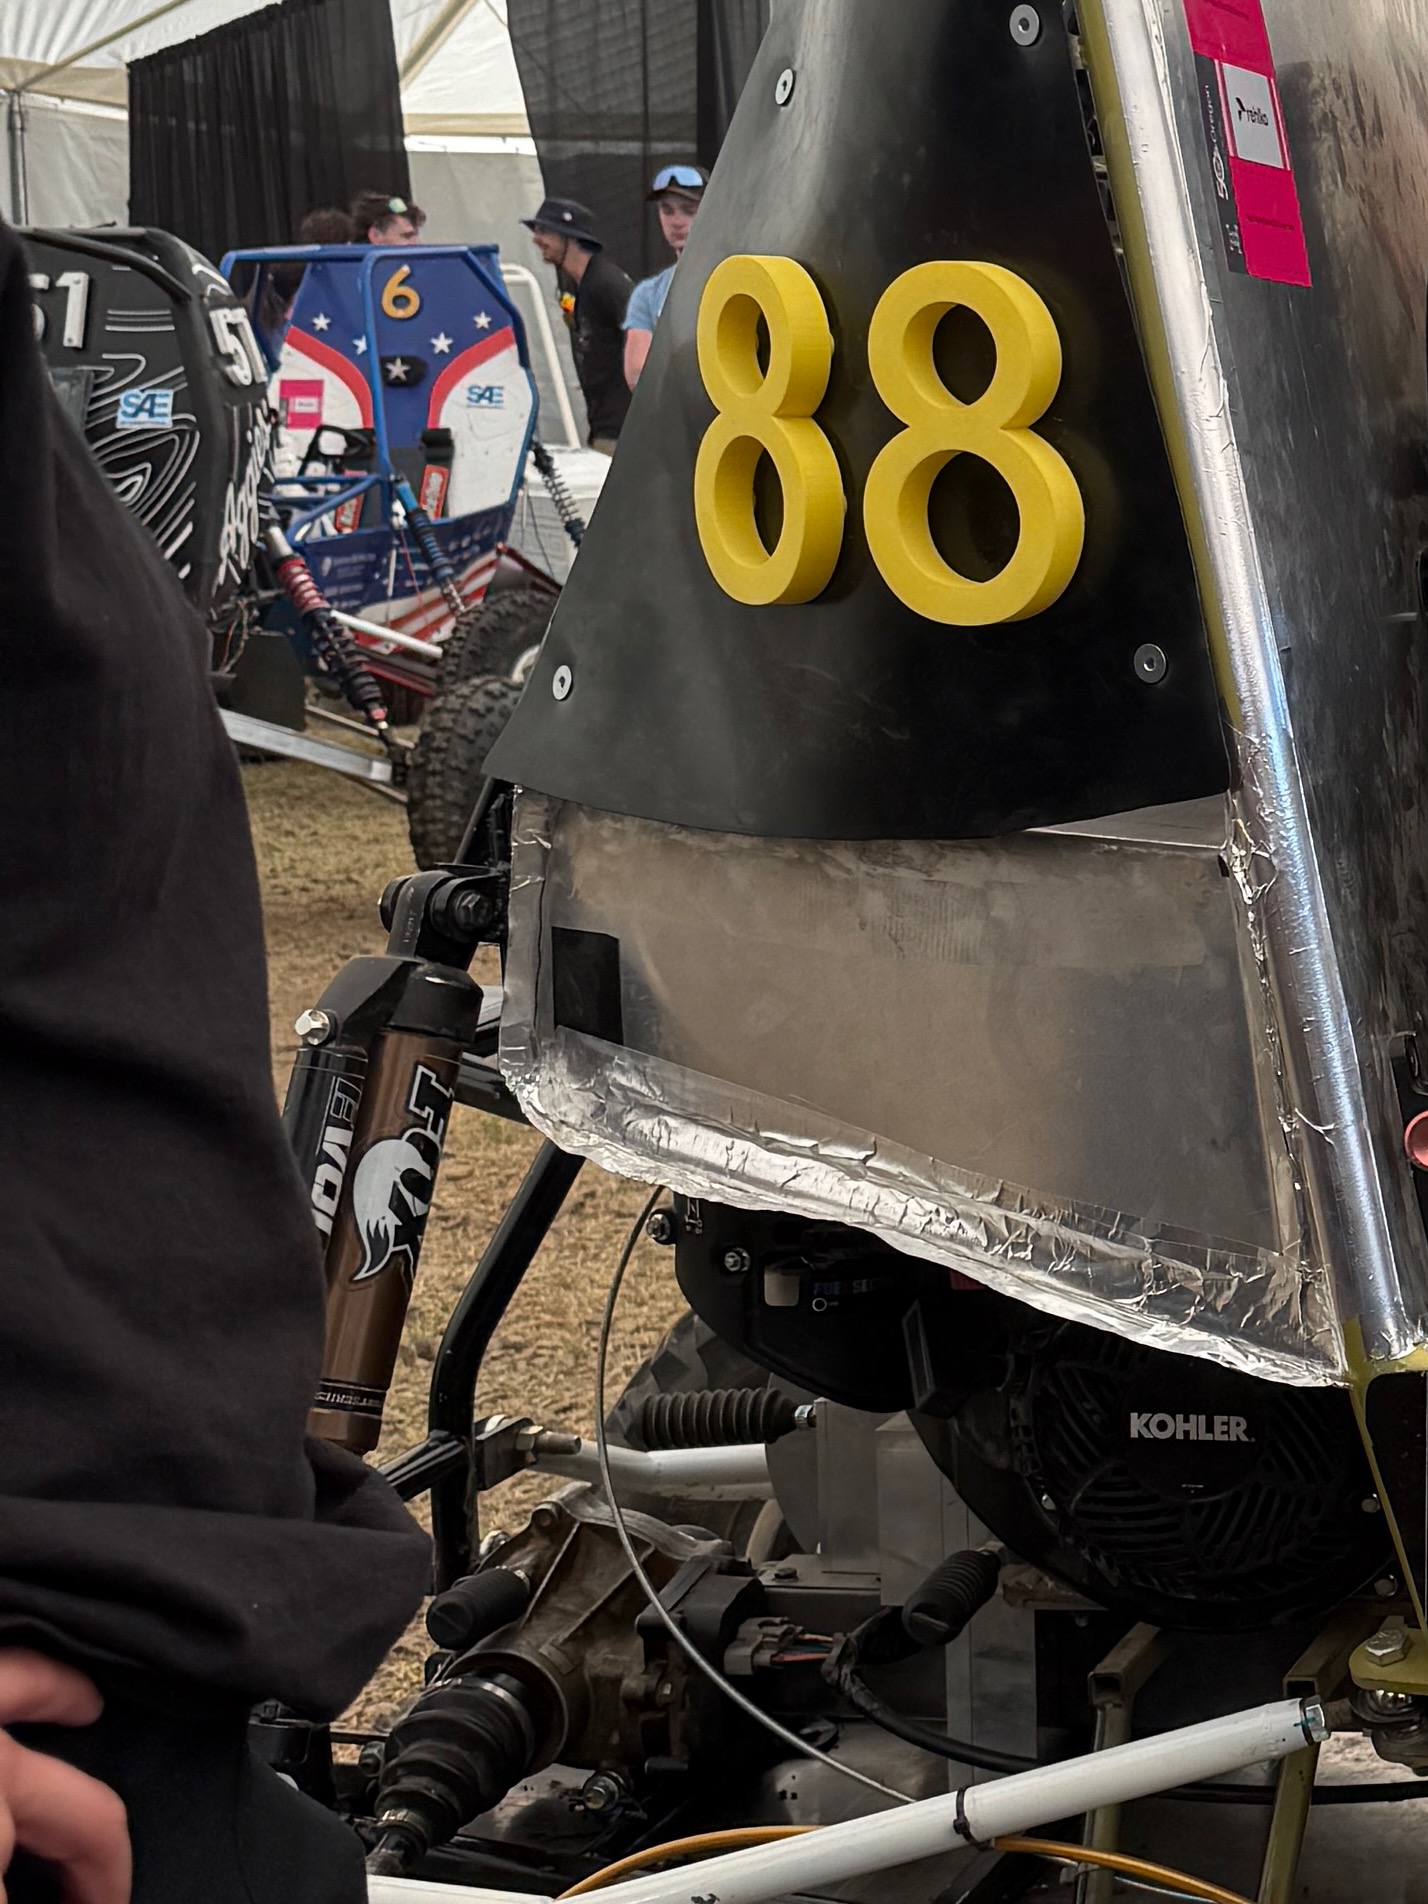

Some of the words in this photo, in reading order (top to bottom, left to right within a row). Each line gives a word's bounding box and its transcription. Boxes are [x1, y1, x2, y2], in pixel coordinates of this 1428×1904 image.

[381, 265, 421, 319] 6
[118, 392, 171, 420] SAE
[466, 385, 504, 404] SAE
[694, 254, 1086, 627] 88
[1129, 1412, 1251, 1443] KOHLER
